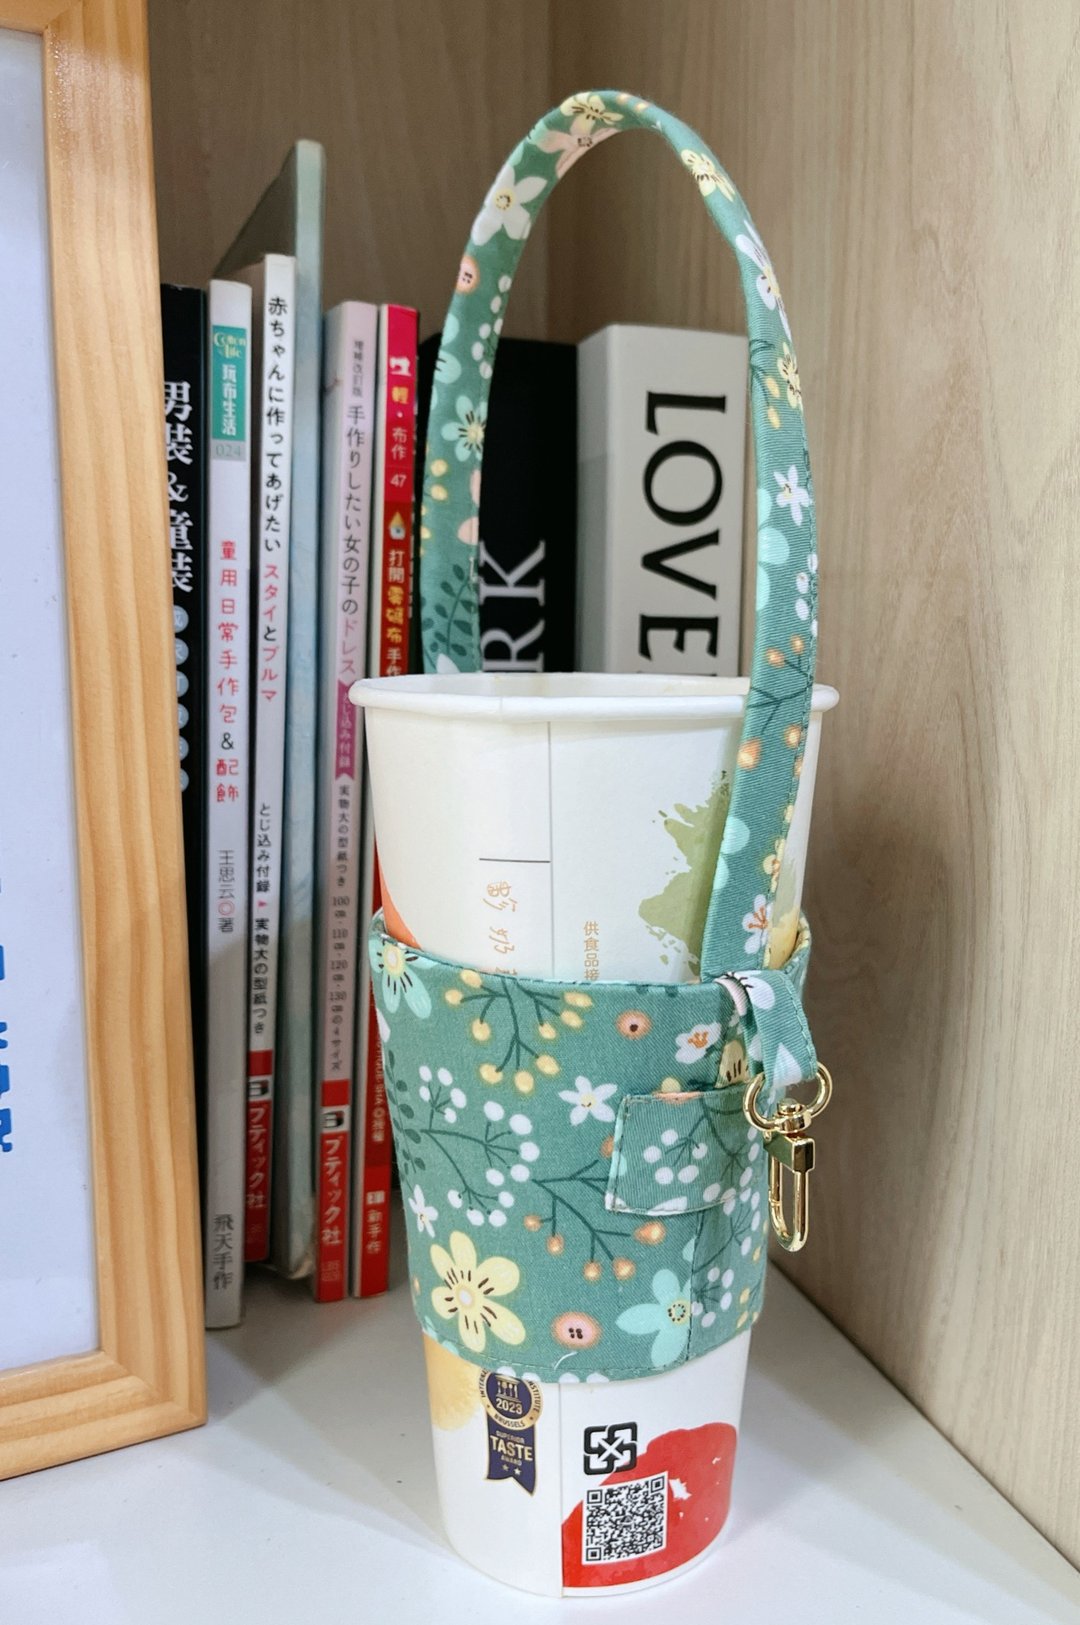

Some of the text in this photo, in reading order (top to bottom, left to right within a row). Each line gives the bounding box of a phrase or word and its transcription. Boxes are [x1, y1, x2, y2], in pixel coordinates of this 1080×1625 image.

[222, 363, 238, 436] 玩布生活
[264, 297, 288, 552] 赤ちゃんに作ってあげたい
[341, 405, 366, 675] 手作りしたい女の子のドレス
[638, 390, 727, 676] LOVE
[479, 540, 546, 672] RK
[253, 803, 272, 1034] とじ込み付録 実物大の型紙つき
[321, 1136, 345, 1246] ブティック社
[212, 1214, 235, 1290] 飛天手作
[490, 1435, 534, 1461] TASTE
[496, 1398, 523, 1415] 2023
[527, 1380, 541, 1413] NSTITUTE
